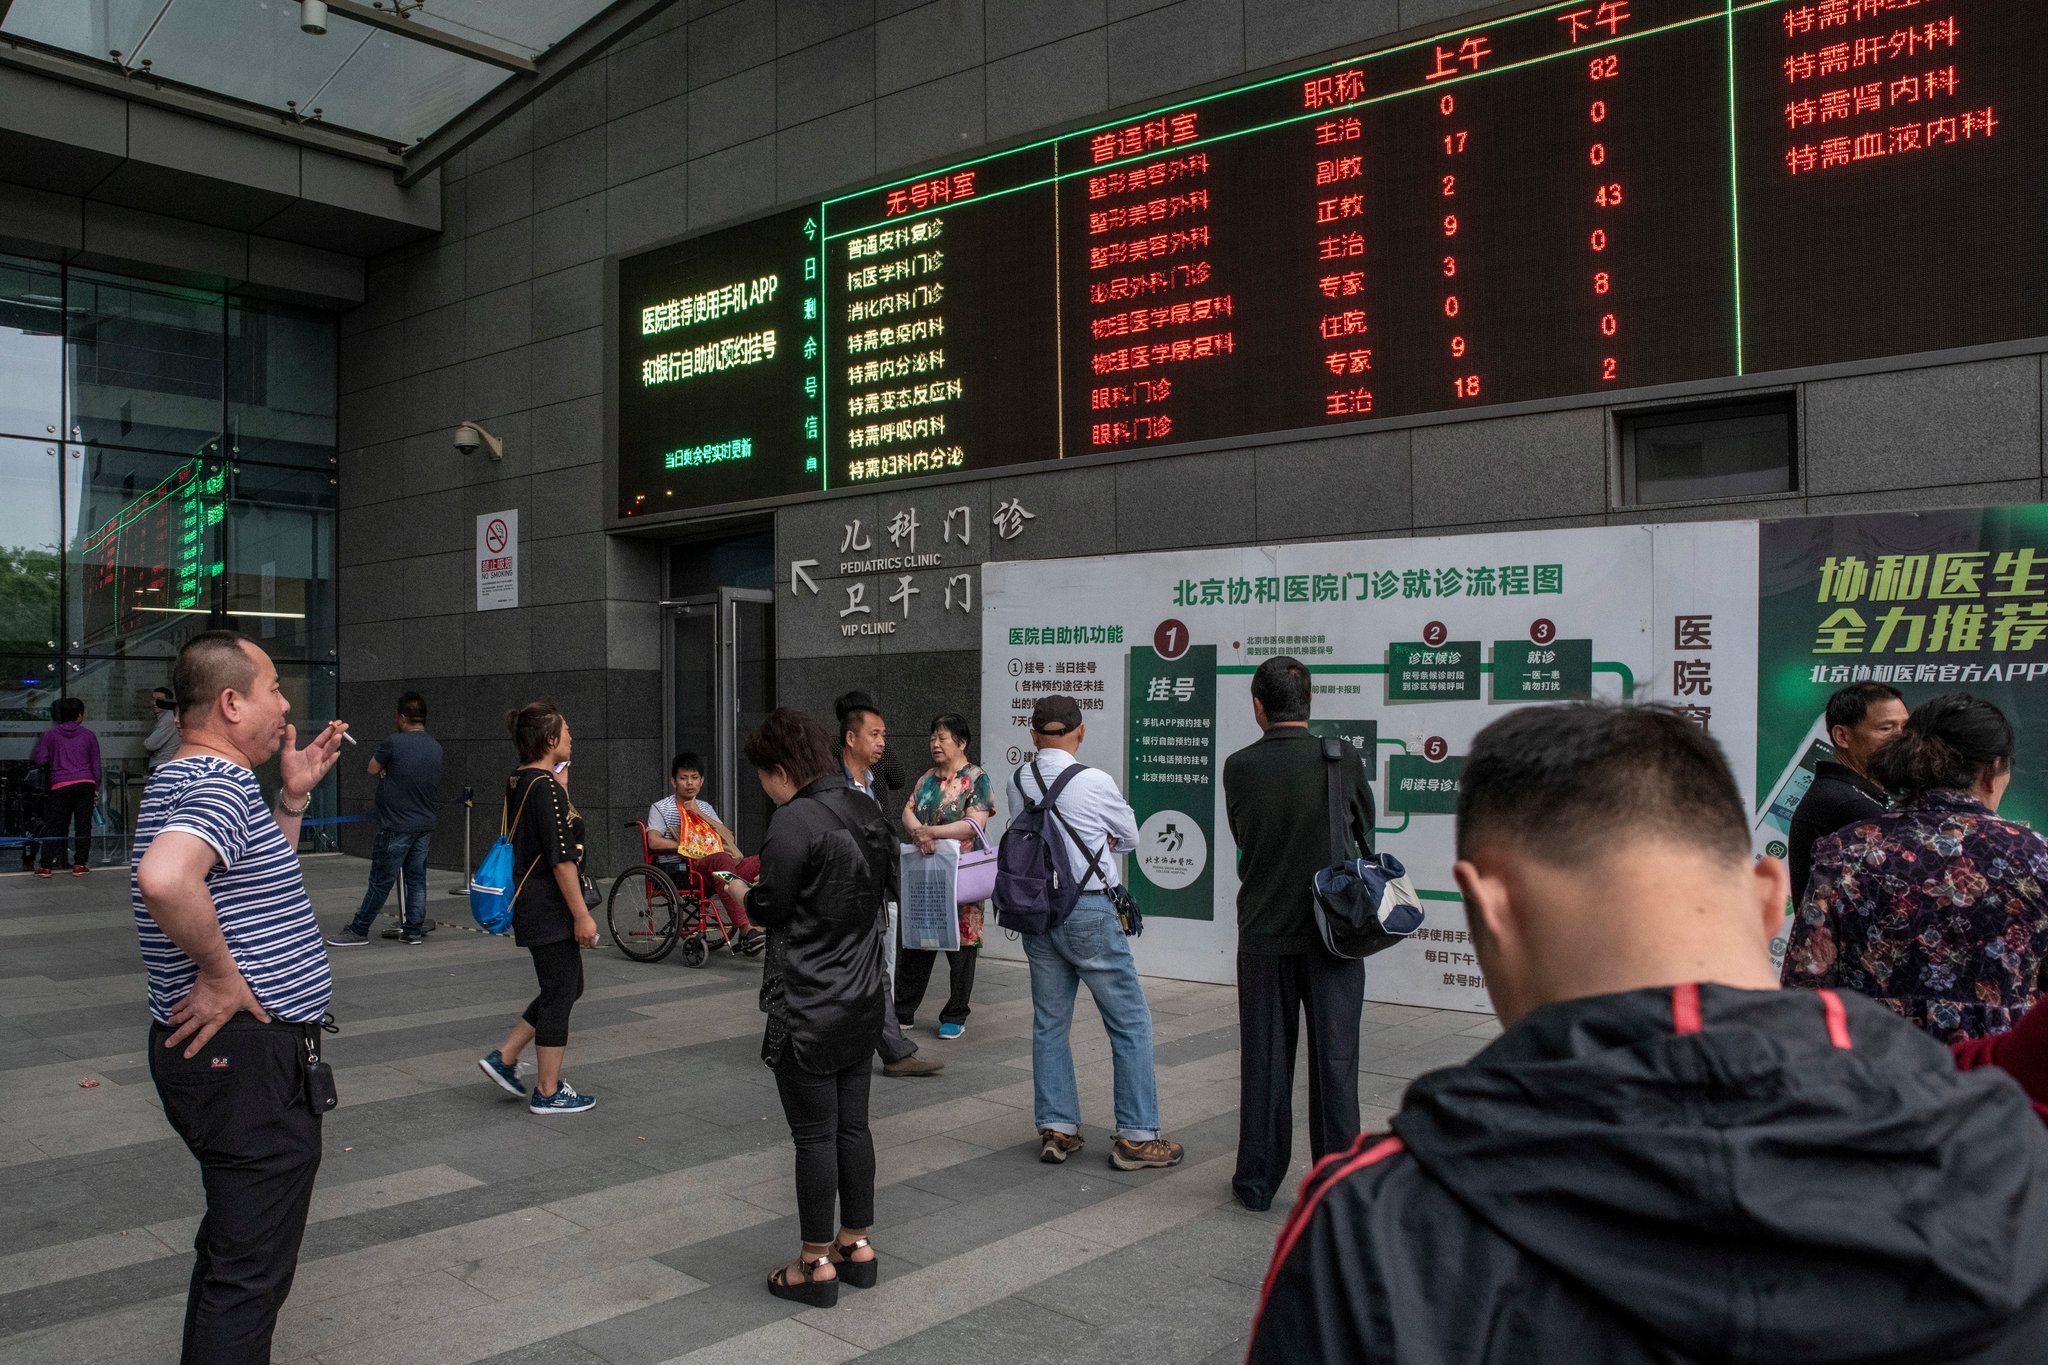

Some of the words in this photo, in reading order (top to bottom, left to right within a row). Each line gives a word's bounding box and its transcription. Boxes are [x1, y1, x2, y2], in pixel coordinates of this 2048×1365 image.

[1557, 0, 1631, 44] 下午
[1425, 36, 1492, 80] 上午
[1784, 15, 1961, 83] 特需肝外科
[1589, 54, 1619, 81] 82
[1303, 69, 1365, 109] 职称
[1785, 65, 1960, 128] 特需肾内科
[1440, 94, 1454, 116] 0
[1590, 100, 1606, 124] 0
[1090, 112, 1199, 163] 普通科室
[1315, 117, 1361, 145] 主治
[1443, 130, 1468, 155] 17
[1786, 106, 1999, 174] 特需血液内科
[1589, 143, 1606, 166] 0
[1089, 153, 1209, 199] 整形美容外科
[1316, 155, 1363, 185] 副教
[886, 172, 975, 217] 无号科室
[1442, 175, 1455, 197] 2
[1594, 183, 1623, 208] 43
[1089, 190, 1209, 235] 整形美容外科
[1316, 194, 1364, 224] 正教
[1443, 214, 1459, 237] 9
[1090, 226, 1210, 270] 整形美容外科
[1319, 233, 1364, 260] 主治
[1590, 228, 1607, 252] 0
[848, 251, 944, 291] 核医学科门诊
[1443, 256, 1457, 278] 3
[1319, 271, 1364, 299] 专家
[1594, 272, 1610, 295] 8
[848, 283, 944, 321] 消化内科门诊
[1444, 296, 1460, 318] 0
[848, 317, 944, 353] 特需免疫内科
[1319, 309, 1367, 339] 住院
[1600, 313, 1618, 337] 0
[642, 329, 777, 388] 和银行自助机预约挂号
[1450, 336, 1466, 358] 9
[848, 349, 945, 385] 特需内分泌科
[1325, 349, 1373, 376] 专家
[1602, 357, 1617, 381] 2
[1091, 377, 1171, 409] 眼科门诊
[1454, 374, 1481, 399] 18
[1326, 390, 1373, 415] 主治
[848, 415, 945, 447] 特需呼吸内科
[1092, 415, 1173, 446] 眼科门诊
[849, 446, 963, 480] 特需妇科内分泌
[840, 498, 1036, 553] 儿科门诊
[482, 572, 488, 580] NO
[490, 570, 513, 578] SMOKING
[840, 557, 902, 574] PEDIATRICS
[904, 553, 941, 568] CLINIC
[1816, 548, 2048, 603] 协和医生
[1172, 564, 1563, 607] 北京协和医院门诊就诊流程图
[842, 624, 858, 636] VIP
[860, 621, 896, 636] CLINIC
[1008, 625, 1124, 646] 医院自助机功能
[1165, 626, 1177, 652] 1
[1246, 635, 1326, 644] 北京市医保患者候诊前
[1430, 626, 1440, 640] 2
[1537, 624, 1548, 638] 3
[1812, 602, 2048, 654] 全力推荐
[1408, 651, 1462, 666] 诊区候诊
[1527, 650, 1556, 664] 就诊
[1522, 670, 1560, 680] 一医一患
[1808, 663, 2048, 683] 北京协和医院官方APP
[1146, 676, 1195, 702] 挂号
[1402, 682, 1464, 691] 到诊区等候呼叫
[1522, 681, 1560, 691] 请勿打扰
[1142, 718, 1210, 728] 手机APP预约挂号
[1142, 736, 1209, 746] 银行自助预约挂号
[1430, 742, 1440, 755] 5
[1142, 755, 1208, 766] 114电话预约挂号
[1142, 773, 1208, 784] 北京预约挂号平台
[1424, 950, 1479, 966] 每日下午
